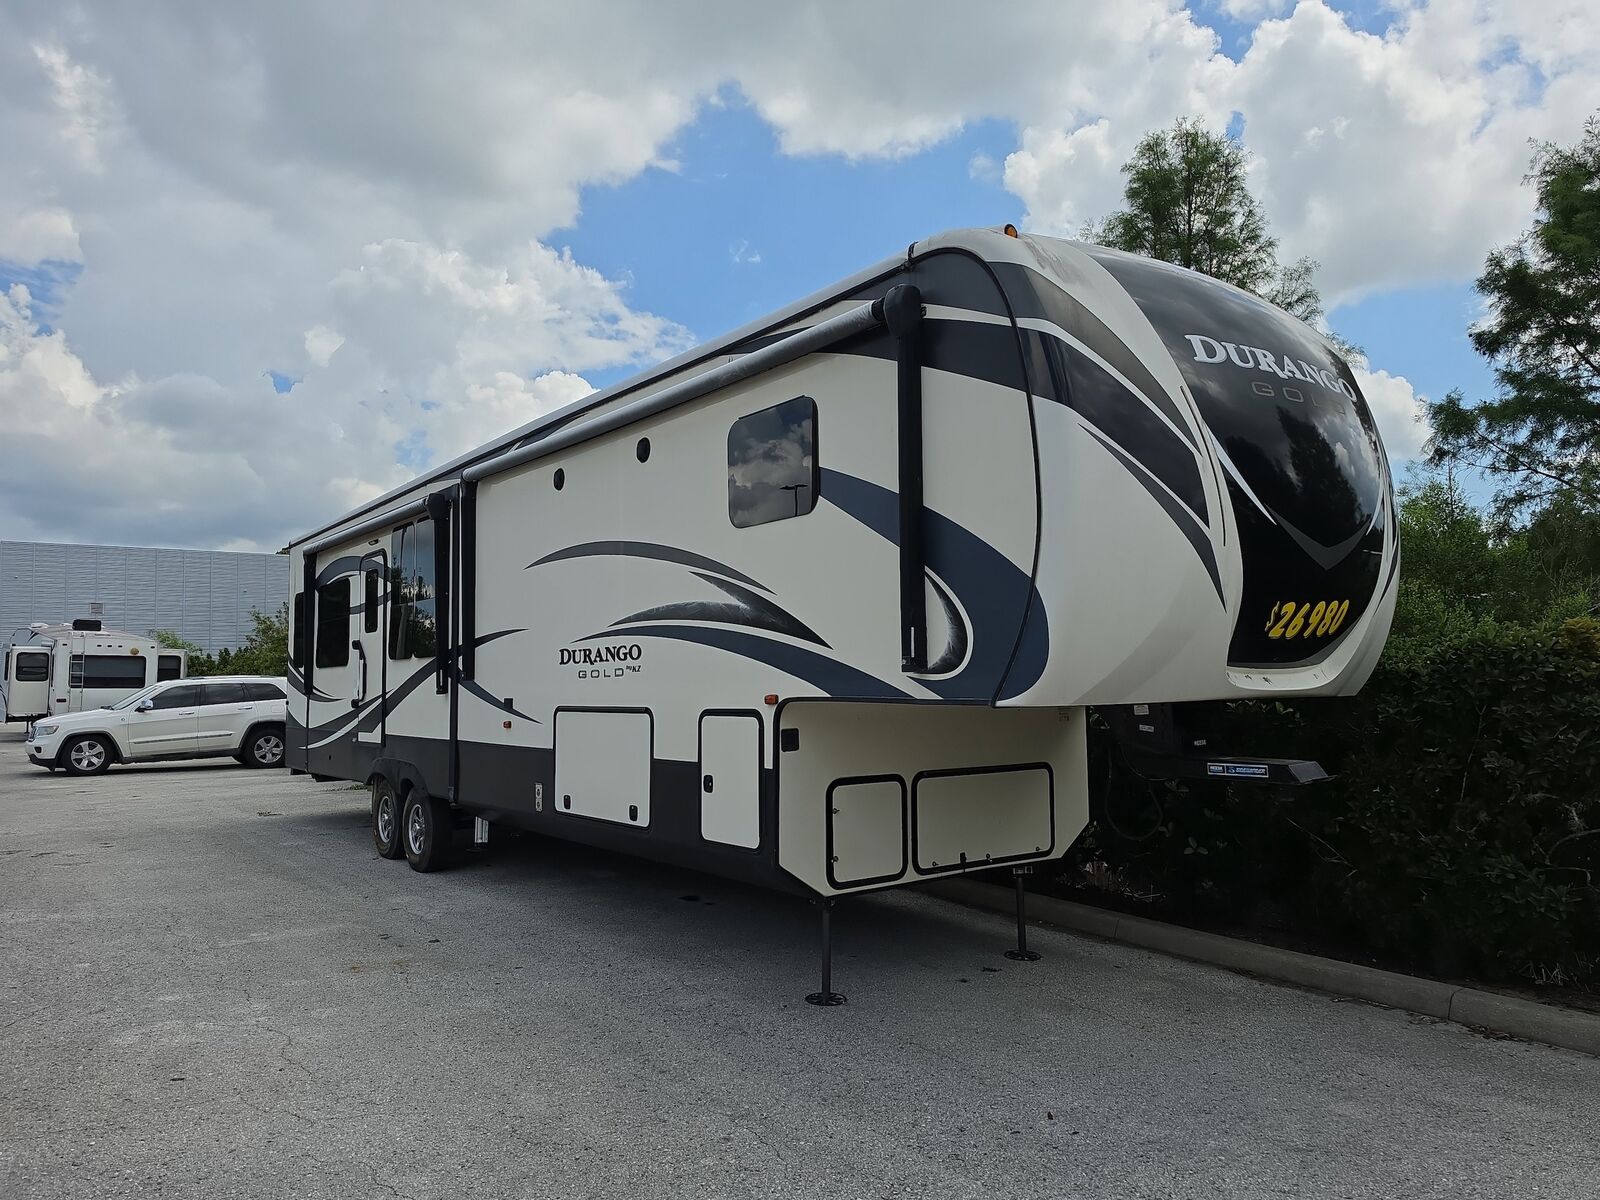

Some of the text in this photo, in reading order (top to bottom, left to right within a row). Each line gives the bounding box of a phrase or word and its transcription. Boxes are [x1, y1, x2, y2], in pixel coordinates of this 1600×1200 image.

[1184, 334, 1357, 403] DURANGO
[1265, 599, 1350, 639] $26980
[559, 644, 642, 665] DURANGO
[578, 668, 624, 679] GOLD
